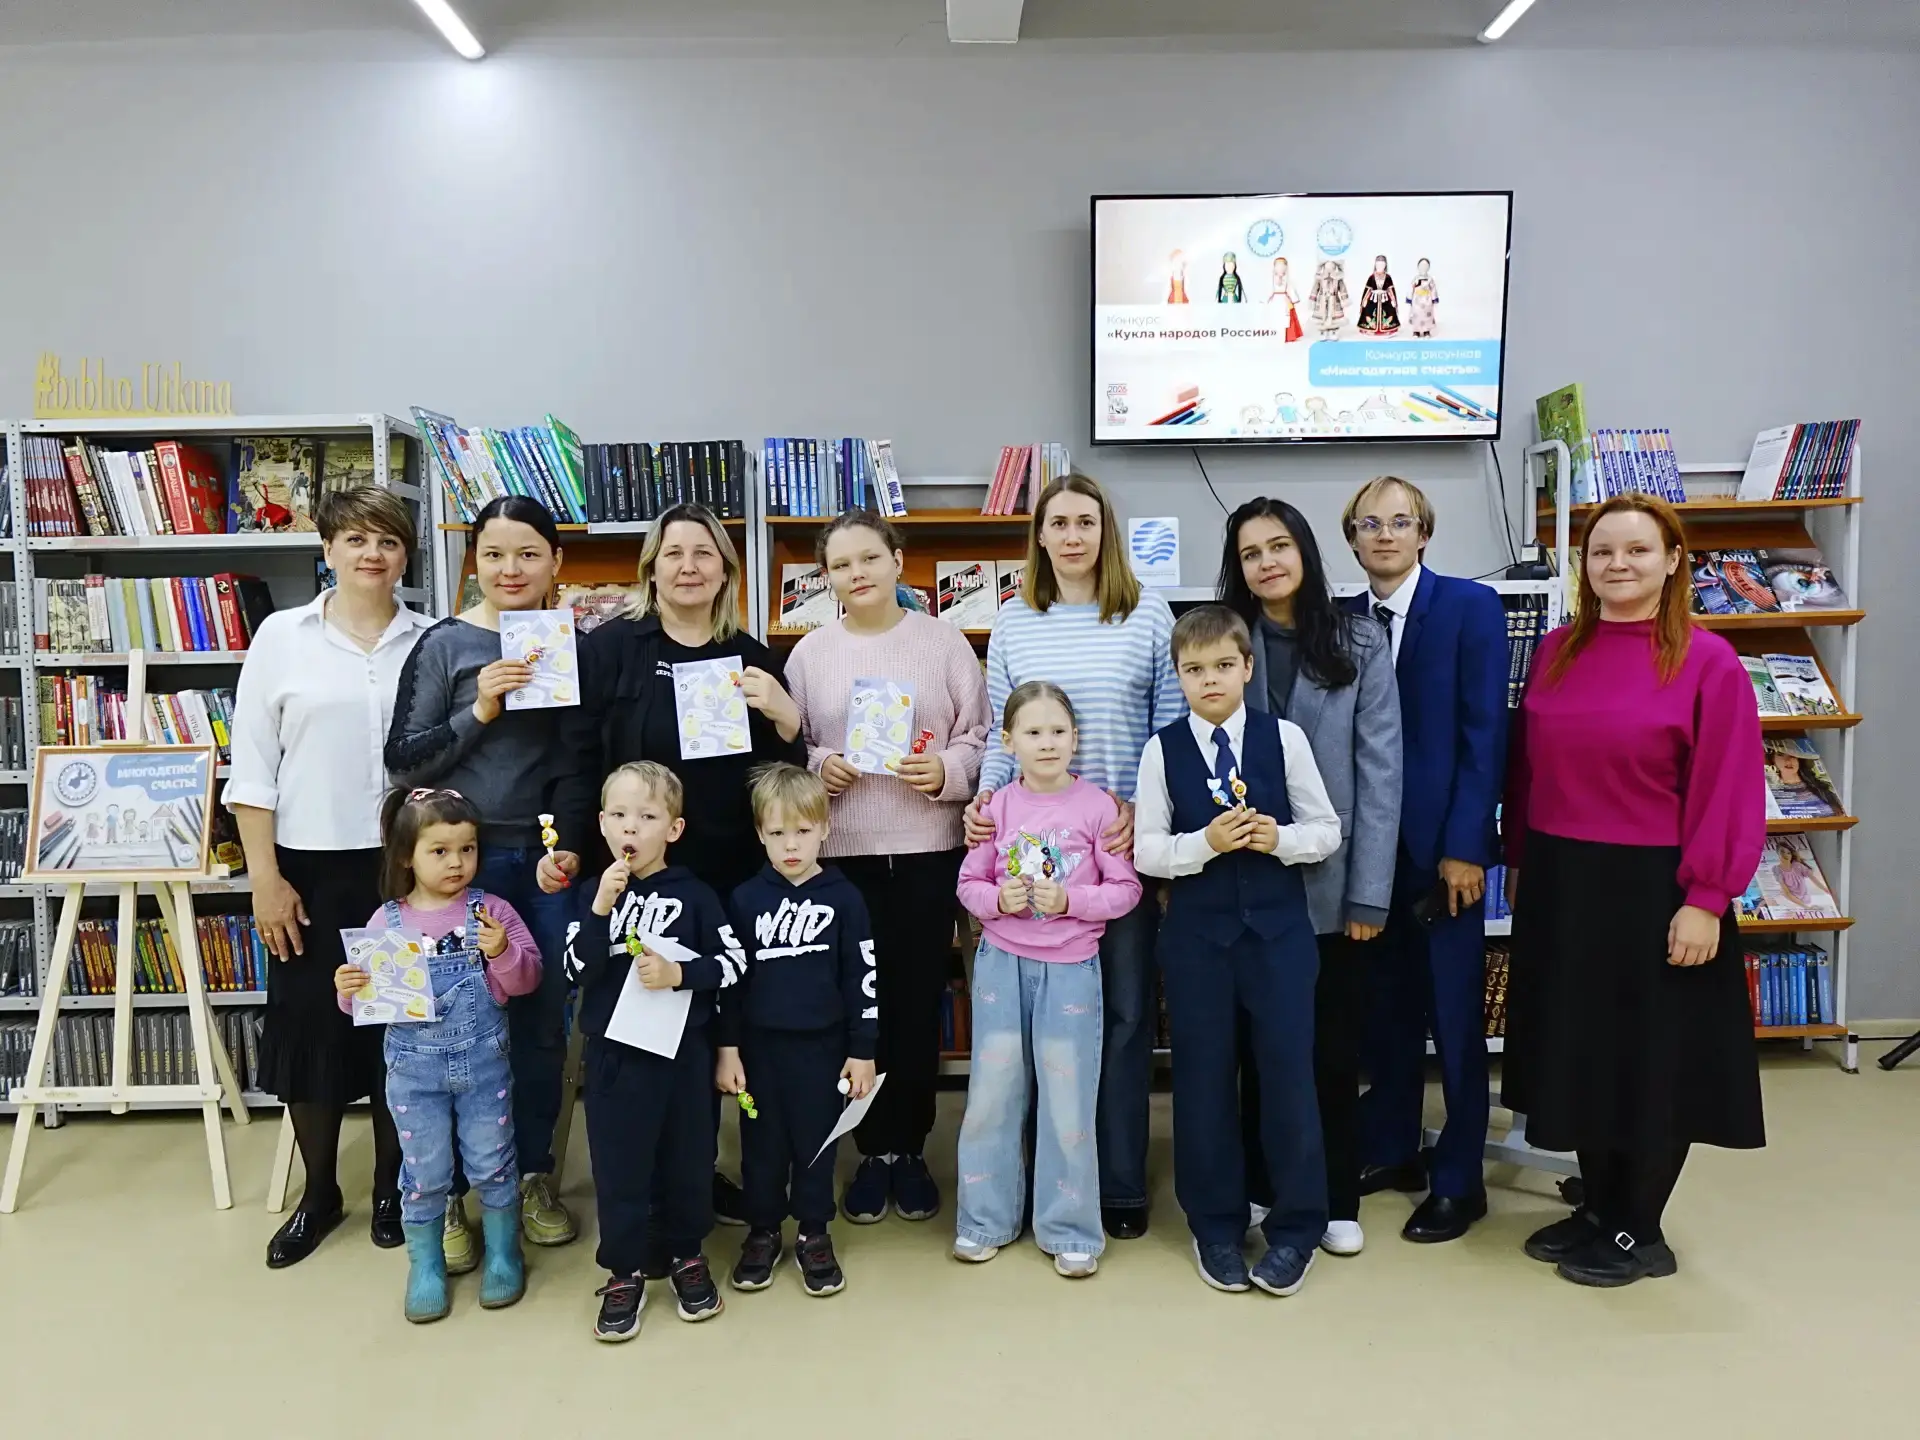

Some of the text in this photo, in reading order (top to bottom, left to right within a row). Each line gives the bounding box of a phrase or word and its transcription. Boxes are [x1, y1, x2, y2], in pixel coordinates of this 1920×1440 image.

[1107, 315, 1161, 327] Конкурс
[1108, 328, 1277, 340] «Кукла народов России»
[1366, 350, 1417, 361] Конкурс
[950, 570, 991, 588] ПАМЯТЬ
[189, 714, 202, 739] КРЫМ
[117, 764, 197, 778] МНОГОДЕТНОЕ
[151, 778, 197, 790] СЧАСТЬЕ
